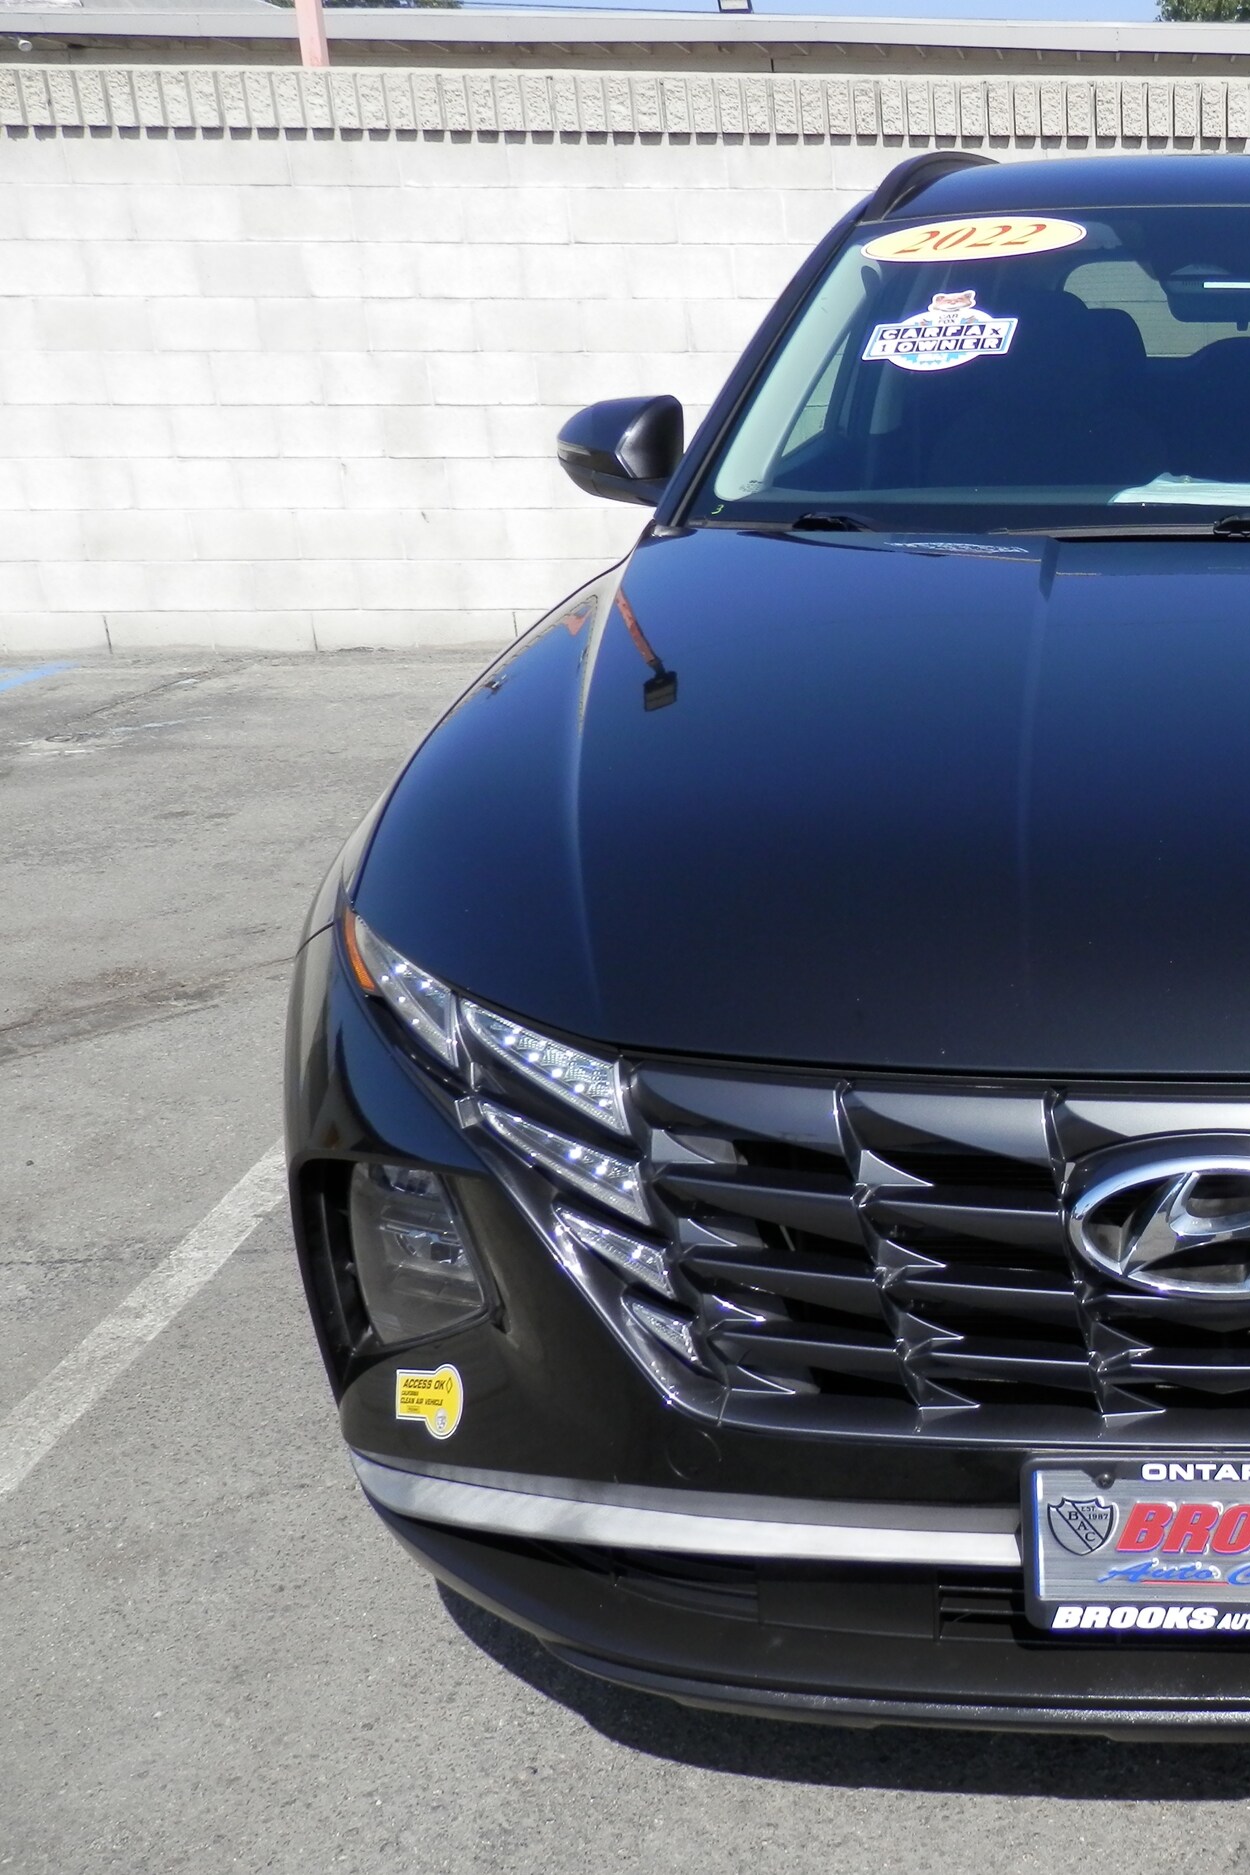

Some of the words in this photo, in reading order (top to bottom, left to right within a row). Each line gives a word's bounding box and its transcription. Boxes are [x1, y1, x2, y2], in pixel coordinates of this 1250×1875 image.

[893, 223, 1047, 254] 2022
[881, 324, 1002, 341] CARFAX
[897, 338, 1000, 353] OWNER
[403, 1378, 432, 1389] ACCESS
[434, 1380, 446, 1390] OK
[1097, 1559, 1215, 1584] Auto
[1051, 1605, 1219, 1630] BROOKS
